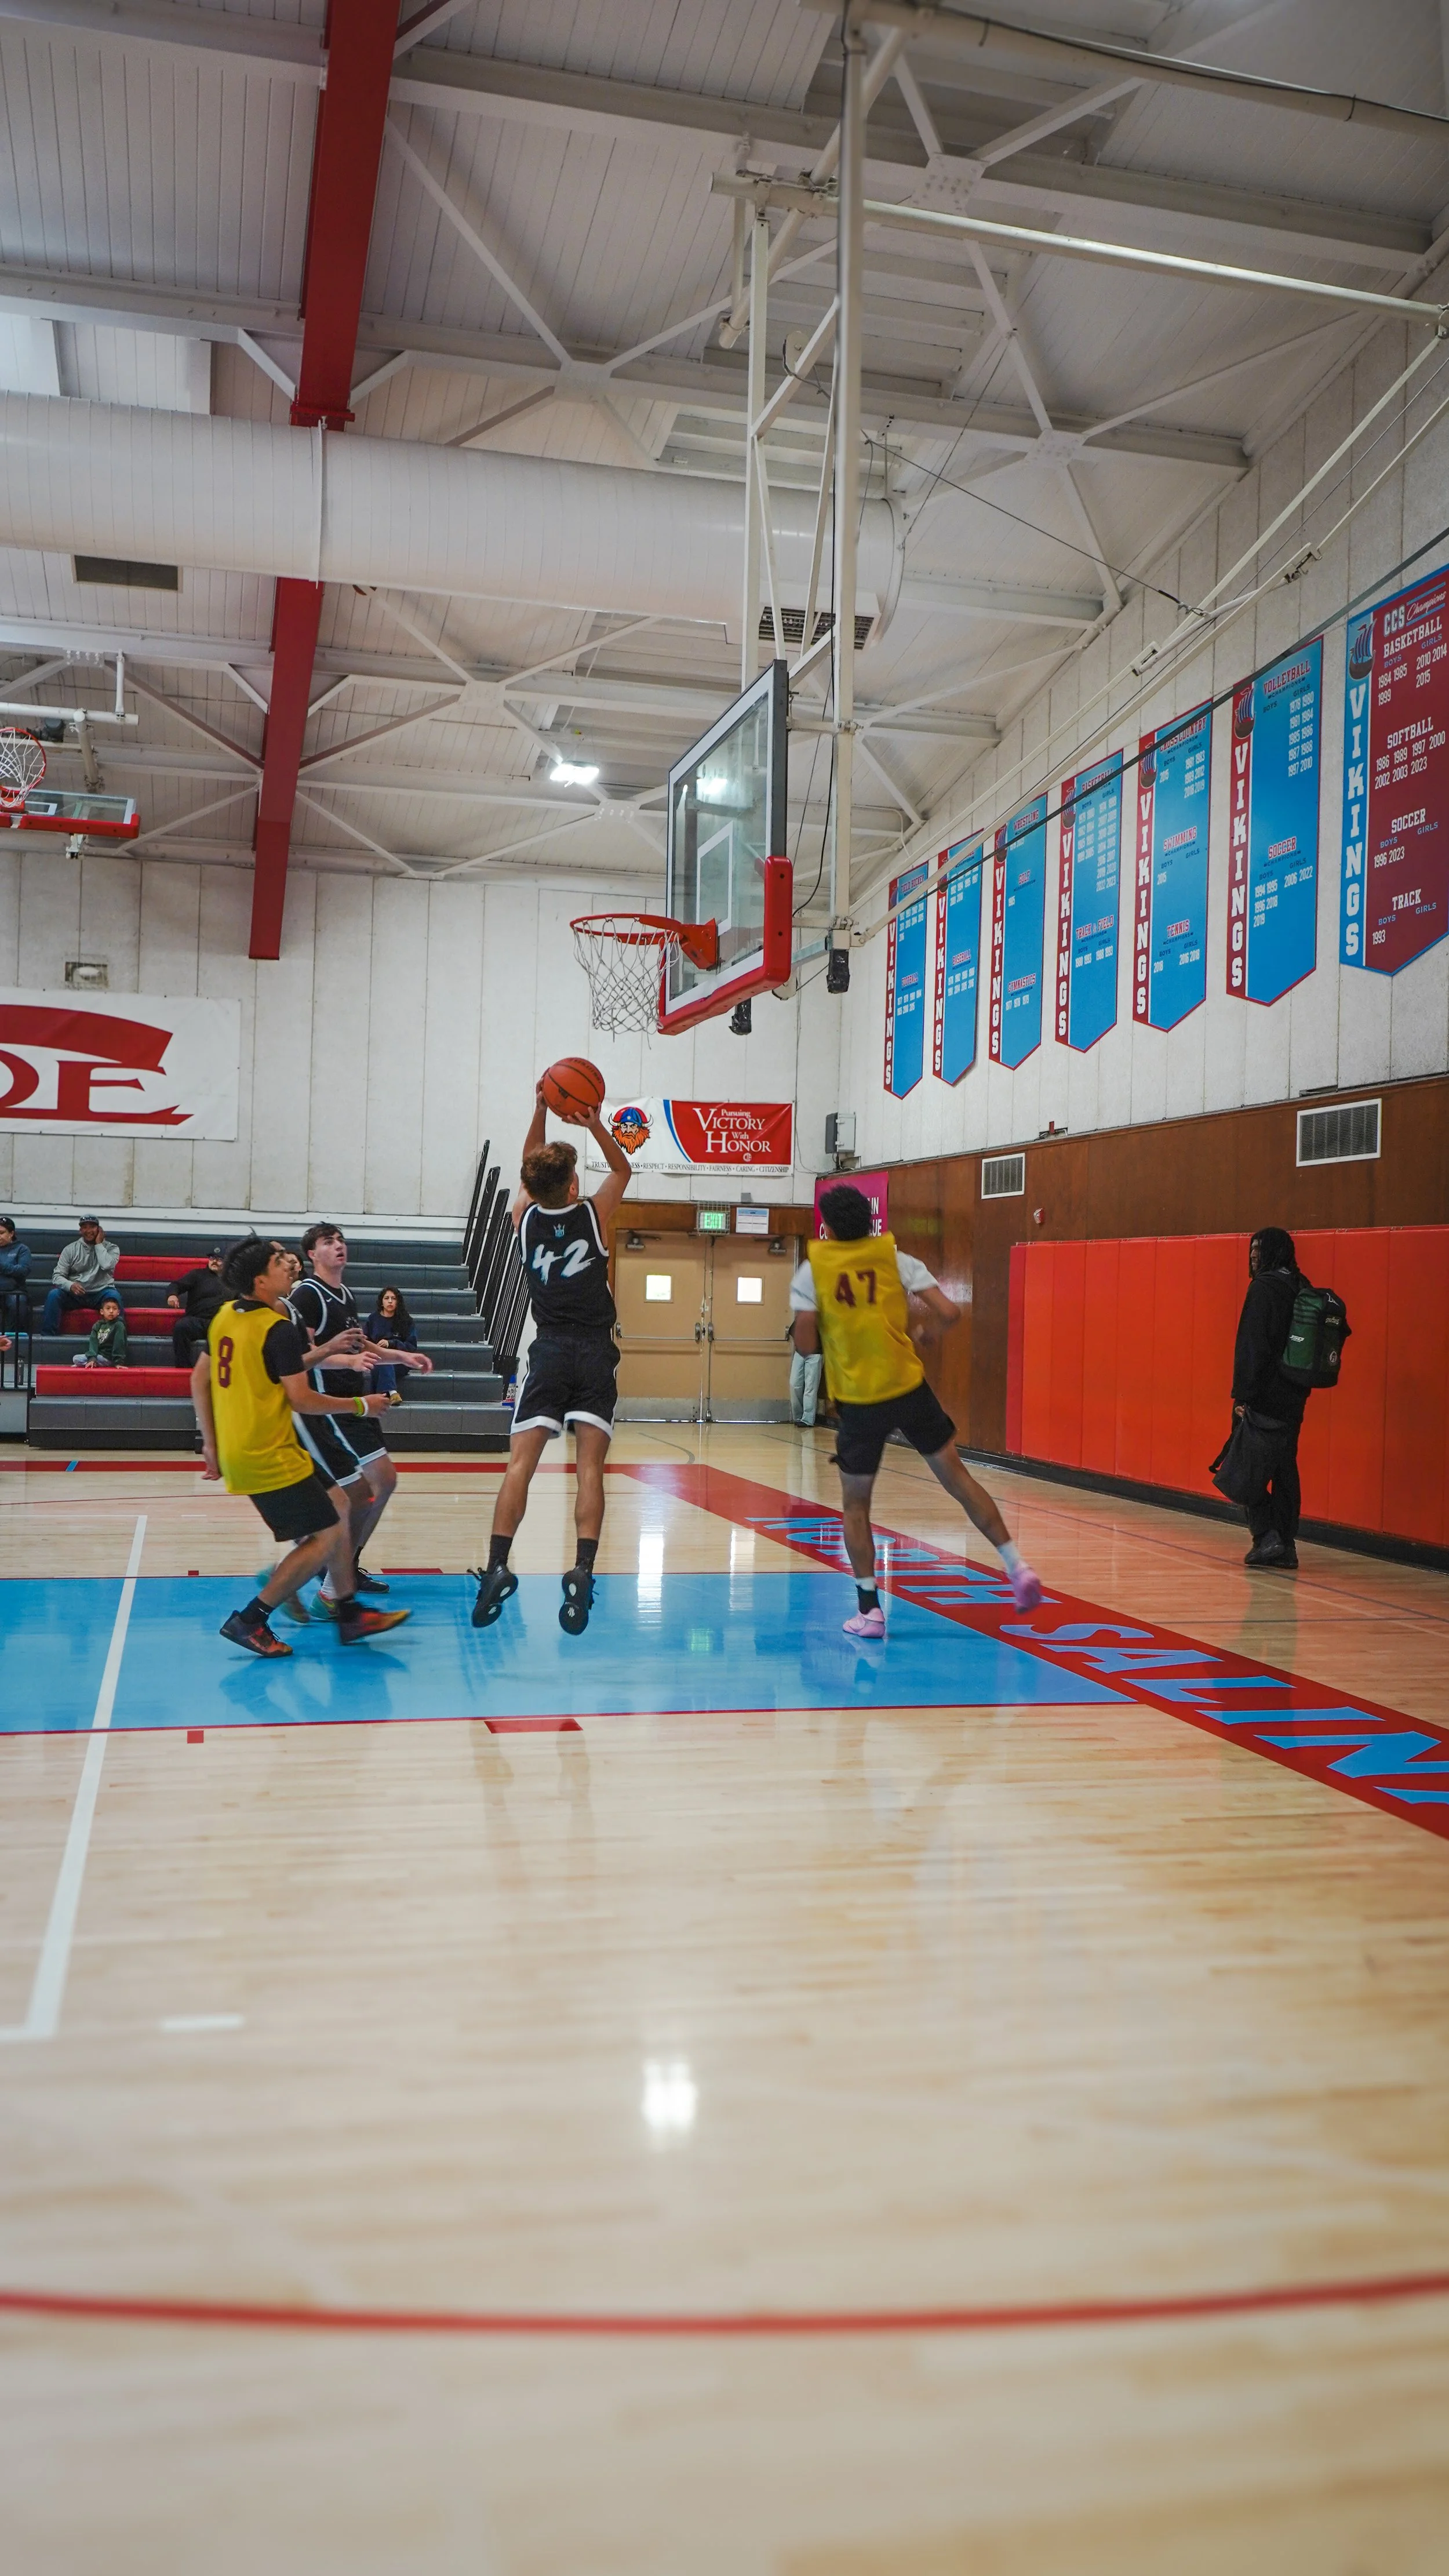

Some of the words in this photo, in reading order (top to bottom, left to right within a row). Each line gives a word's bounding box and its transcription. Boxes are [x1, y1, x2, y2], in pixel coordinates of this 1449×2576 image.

[1384, 605, 1406, 637] CCS
[1407, 591, 1447, 621] Champions
[1384, 616, 1443, 659] BASKETBALL
[1421, 634, 1443, 649] GIRLS
[1384, 654, 1402, 668] BOYS
[1416, 651, 1431, 670] 2010
[1432, 642, 1447, 662] 2014
[1264, 659, 1311, 695] VOLLEYBALL
[1378, 671, 1392, 689] 1984
[1393, 663, 1407, 681] 1985
[1416, 668, 1430, 688] 2015
[1293, 684, 1310, 697] GIRLS
[1378, 688, 1392, 706] 1999
[1263, 700, 1277, 713] BOYS
[1387, 716, 1433, 749] SOFTBALL
[1376, 754, 1390, 772] 1986
[1393, 747, 1408, 764] 1989
[1412, 739, 1426, 757] 1997
[1429, 731, 1446, 750] 2000
[1375, 772, 1390, 790] 2002
[1392, 764, 1408, 782] 2003
[1411, 756, 1427, 775] 2023
[1345, 683, 1367, 957] VIKINGS
[1391, 808, 1426, 834] SOCCER
[1417, 822, 1438, 835] GIRLS
[1163, 826, 1197, 852] SWIMMING
[1268, 837, 1297, 859] SOCCER
[1380, 837, 1398, 848] BOYS
[1185, 848, 1200, 859] GIRLS
[1231, 742, 1248, 987] VIKINGS
[1289, 858, 1306, 869] GIRLS
[1374, 852, 1387, 869] 1996
[1389, 846, 1405, 863] 2023
[1259, 870, 1274, 880] BOYS
[1299, 866, 1313, 881] 2022
[1136, 791, 1152, 1015] VIKINGS
[1392, 888, 1421, 911] TRACK
[1415, 902, 1437, 914] GIRLS
[1076, 923, 1092, 940] TRACK
[1097, 914, 1114, 932] FIELD
[1167, 919, 1190, 938] TENNIS
[1378, 914, 1396, 925] BOYS
[1058, 831, 1072, 1037] VIKINGS
[1372, 929, 1386, 945] 1993
[992, 866, 1004, 1055] VIKINGS
[934, 896, 946, 1071] VIKINGS
[885, 921, 896, 1085] VIKINGS
[693, 1107, 766, 1131] VICTORY
[721, 1109, 751, 1118] Pursuing
[705, 1131, 771, 1153] HONOR
[731, 1131, 749, 1140] With
[668, 1163, 707, 1171] RESPONSIBILITY
[704, 1212, 723, 1229] EXIT
[531, 1238, 596, 1285] 42
[835, 1270, 877, 1309] 47
[217, 1336, 234, 1389] 8
[744, 1517, 1063, 1605] NORTH
